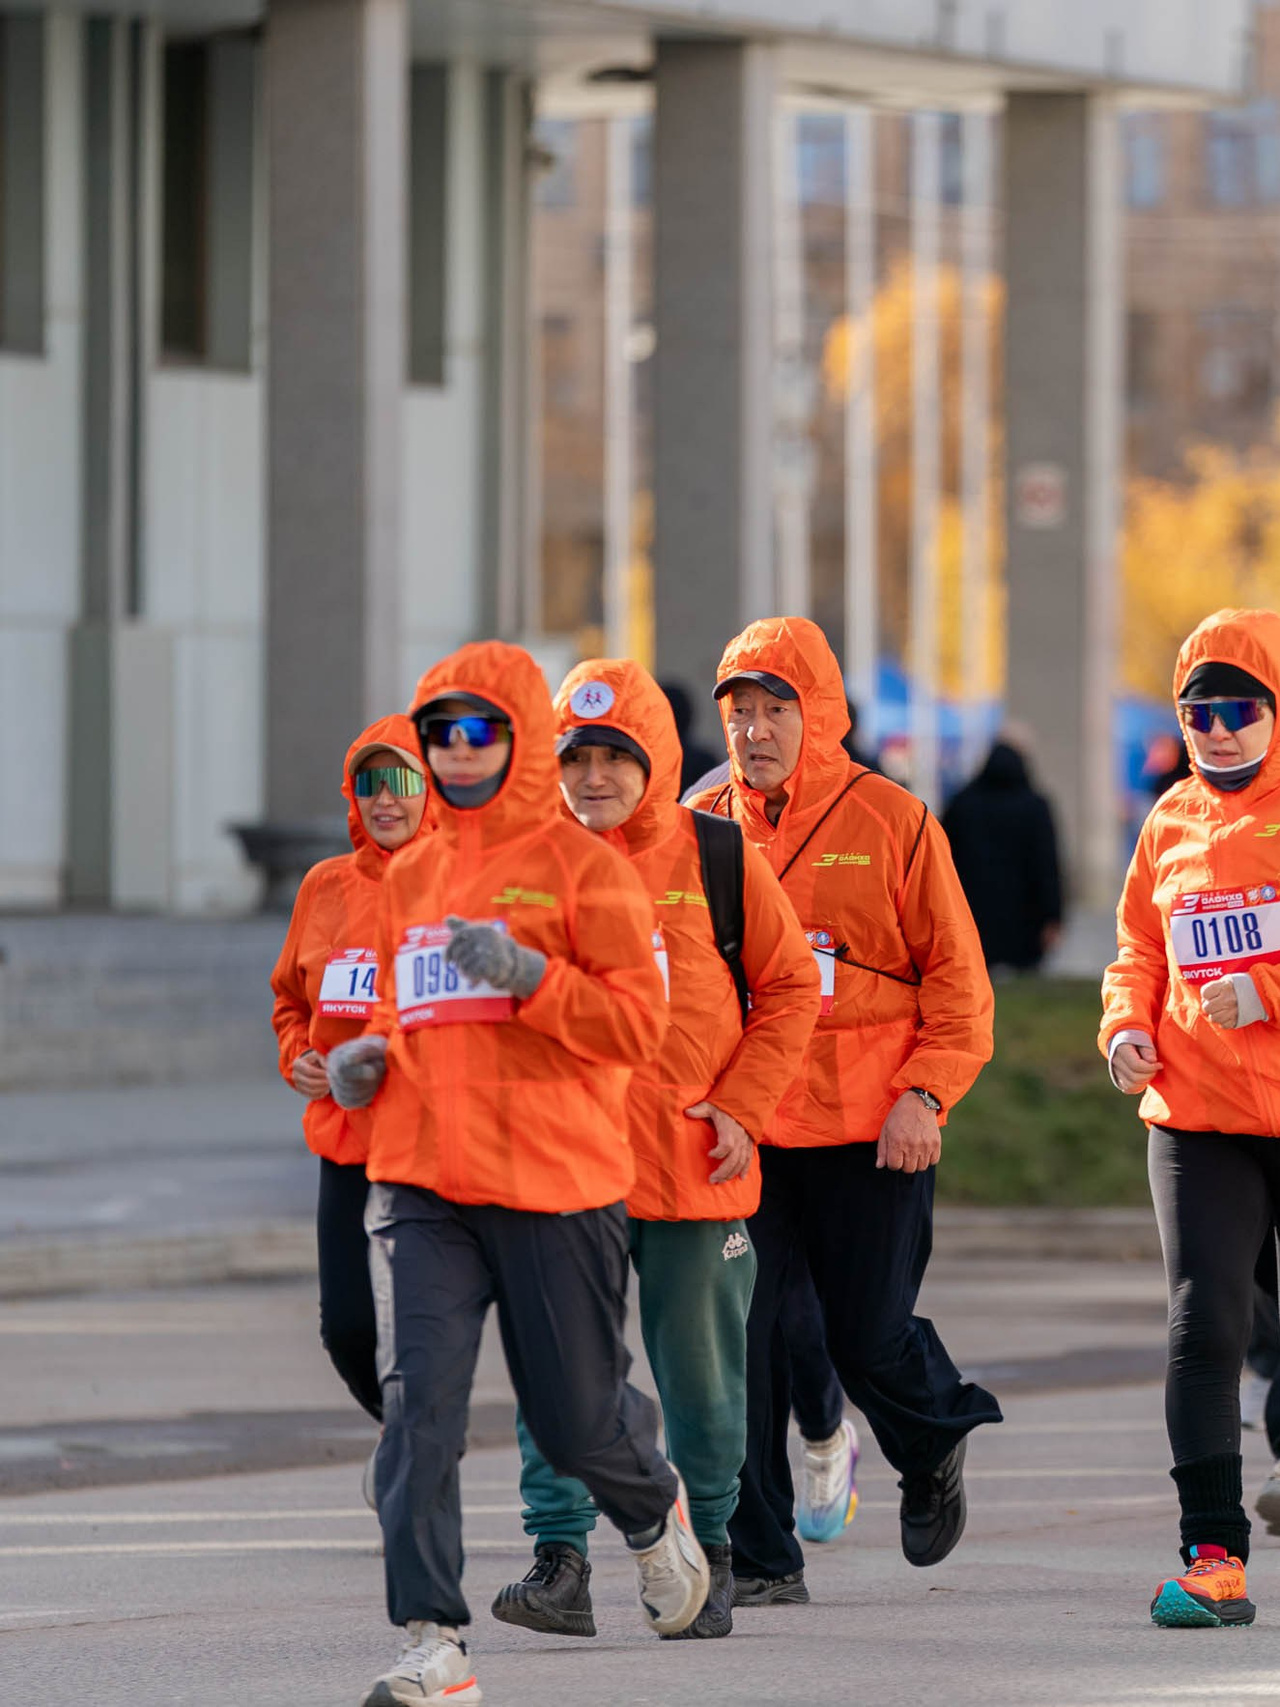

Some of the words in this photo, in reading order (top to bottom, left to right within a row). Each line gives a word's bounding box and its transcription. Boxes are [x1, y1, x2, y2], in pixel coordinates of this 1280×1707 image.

[1192, 912, 1262, 958] 0108
[414, 952, 475, 998] 098
[1182, 967, 1223, 980] ЯКУТСК
[322, 1003, 367, 1014] ЯКУТСК
